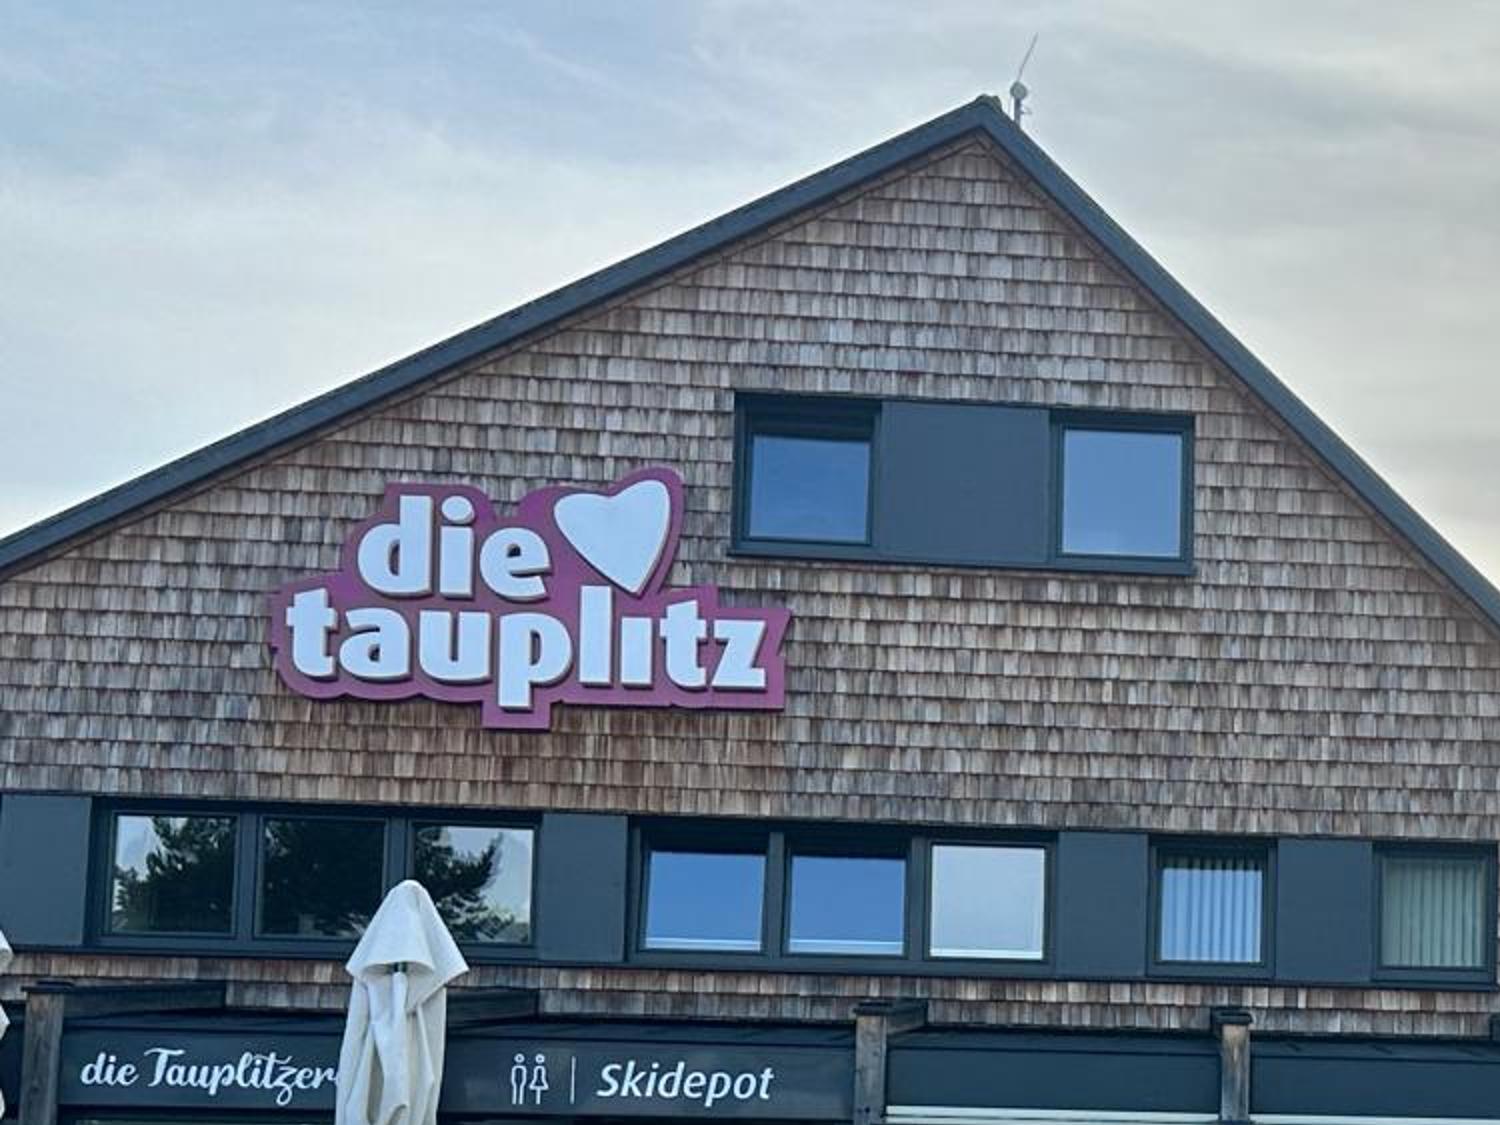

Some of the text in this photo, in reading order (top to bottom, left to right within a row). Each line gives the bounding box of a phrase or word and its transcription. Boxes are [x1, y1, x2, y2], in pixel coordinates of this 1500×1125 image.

[356, 494, 551, 600] die
[286, 584, 768, 711] tauplitz
[80, 1052, 138, 1087] die
[596, 1059, 775, 1107] Skidepot
